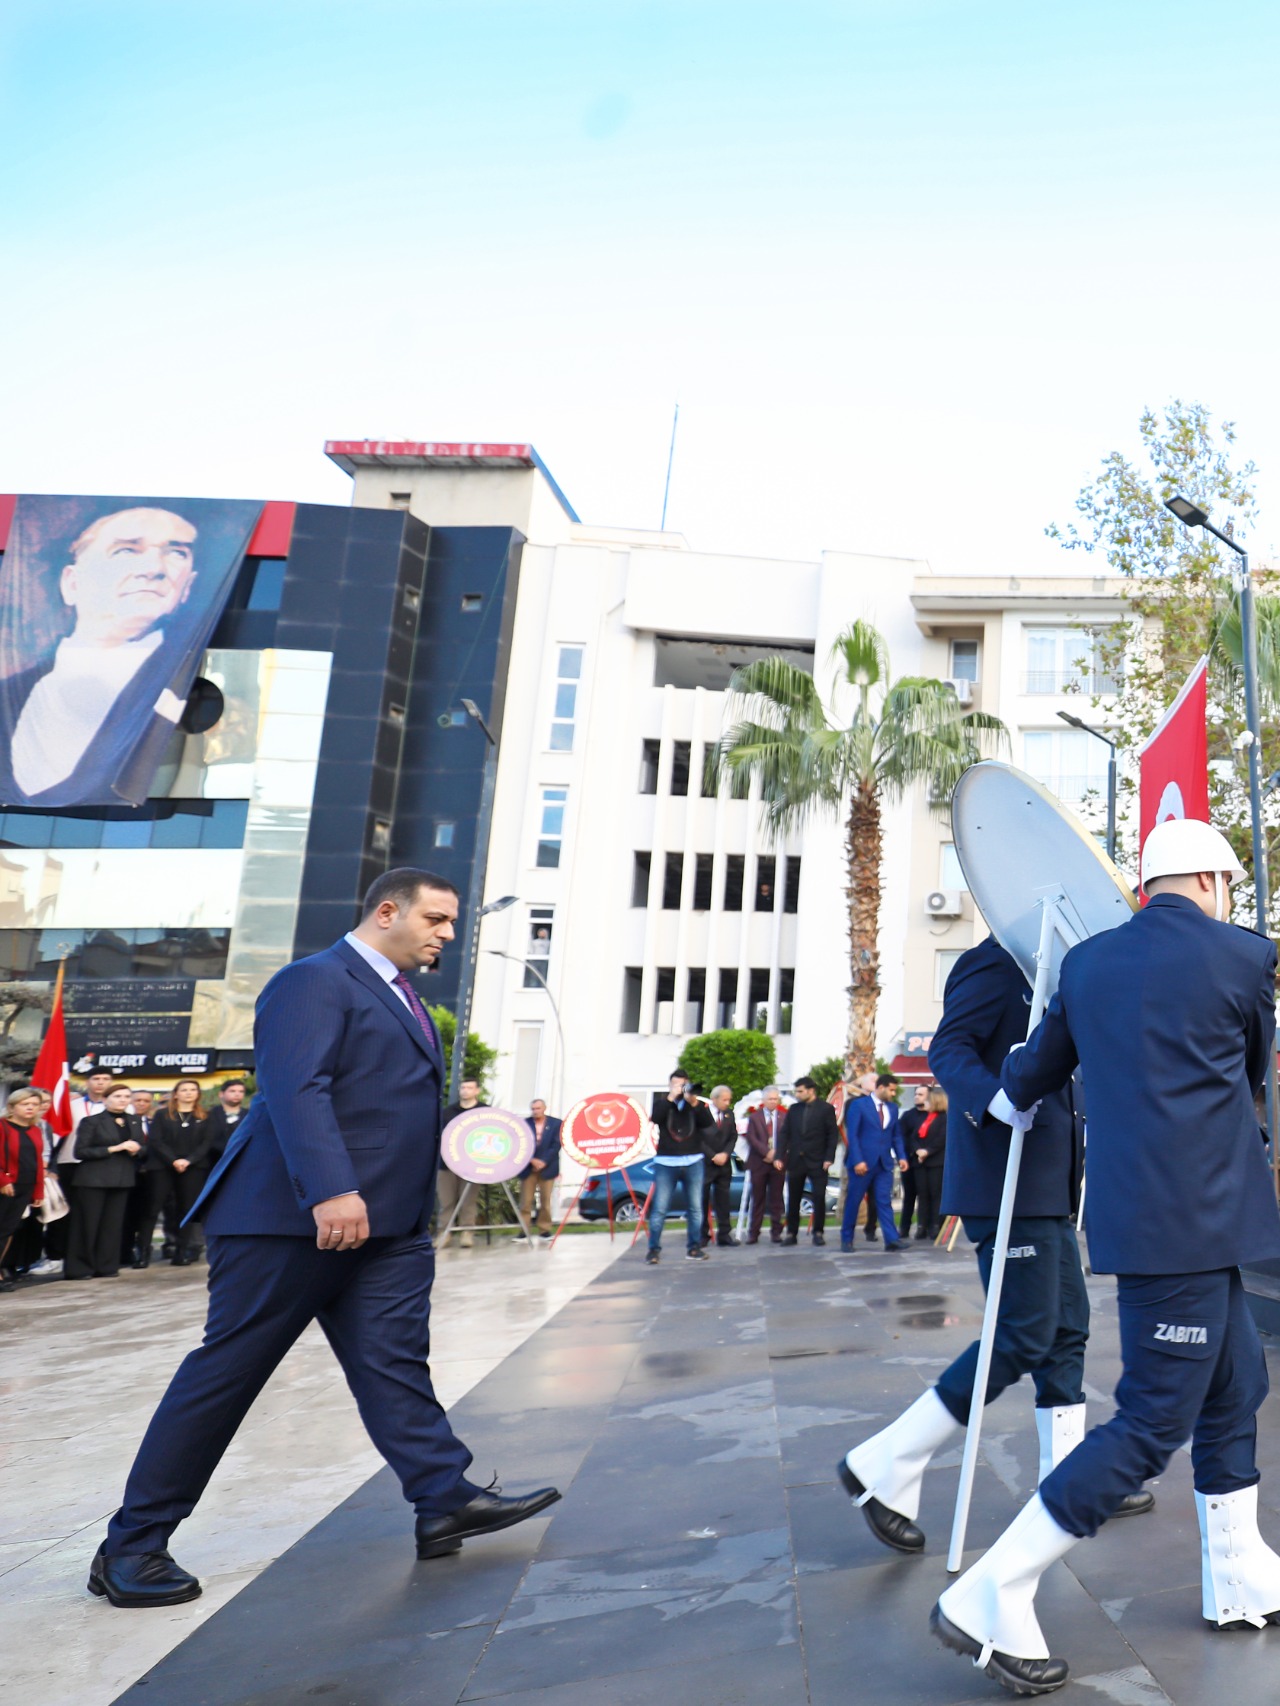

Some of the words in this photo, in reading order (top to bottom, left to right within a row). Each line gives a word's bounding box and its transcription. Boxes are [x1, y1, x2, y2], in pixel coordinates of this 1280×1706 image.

[98, 1054, 147, 1067] KIZART
[154, 1053, 208, 1067] CHICKEN
[992, 1245, 1037, 1259] ABITA
[1153, 1323, 1208, 1344] ZABITA
